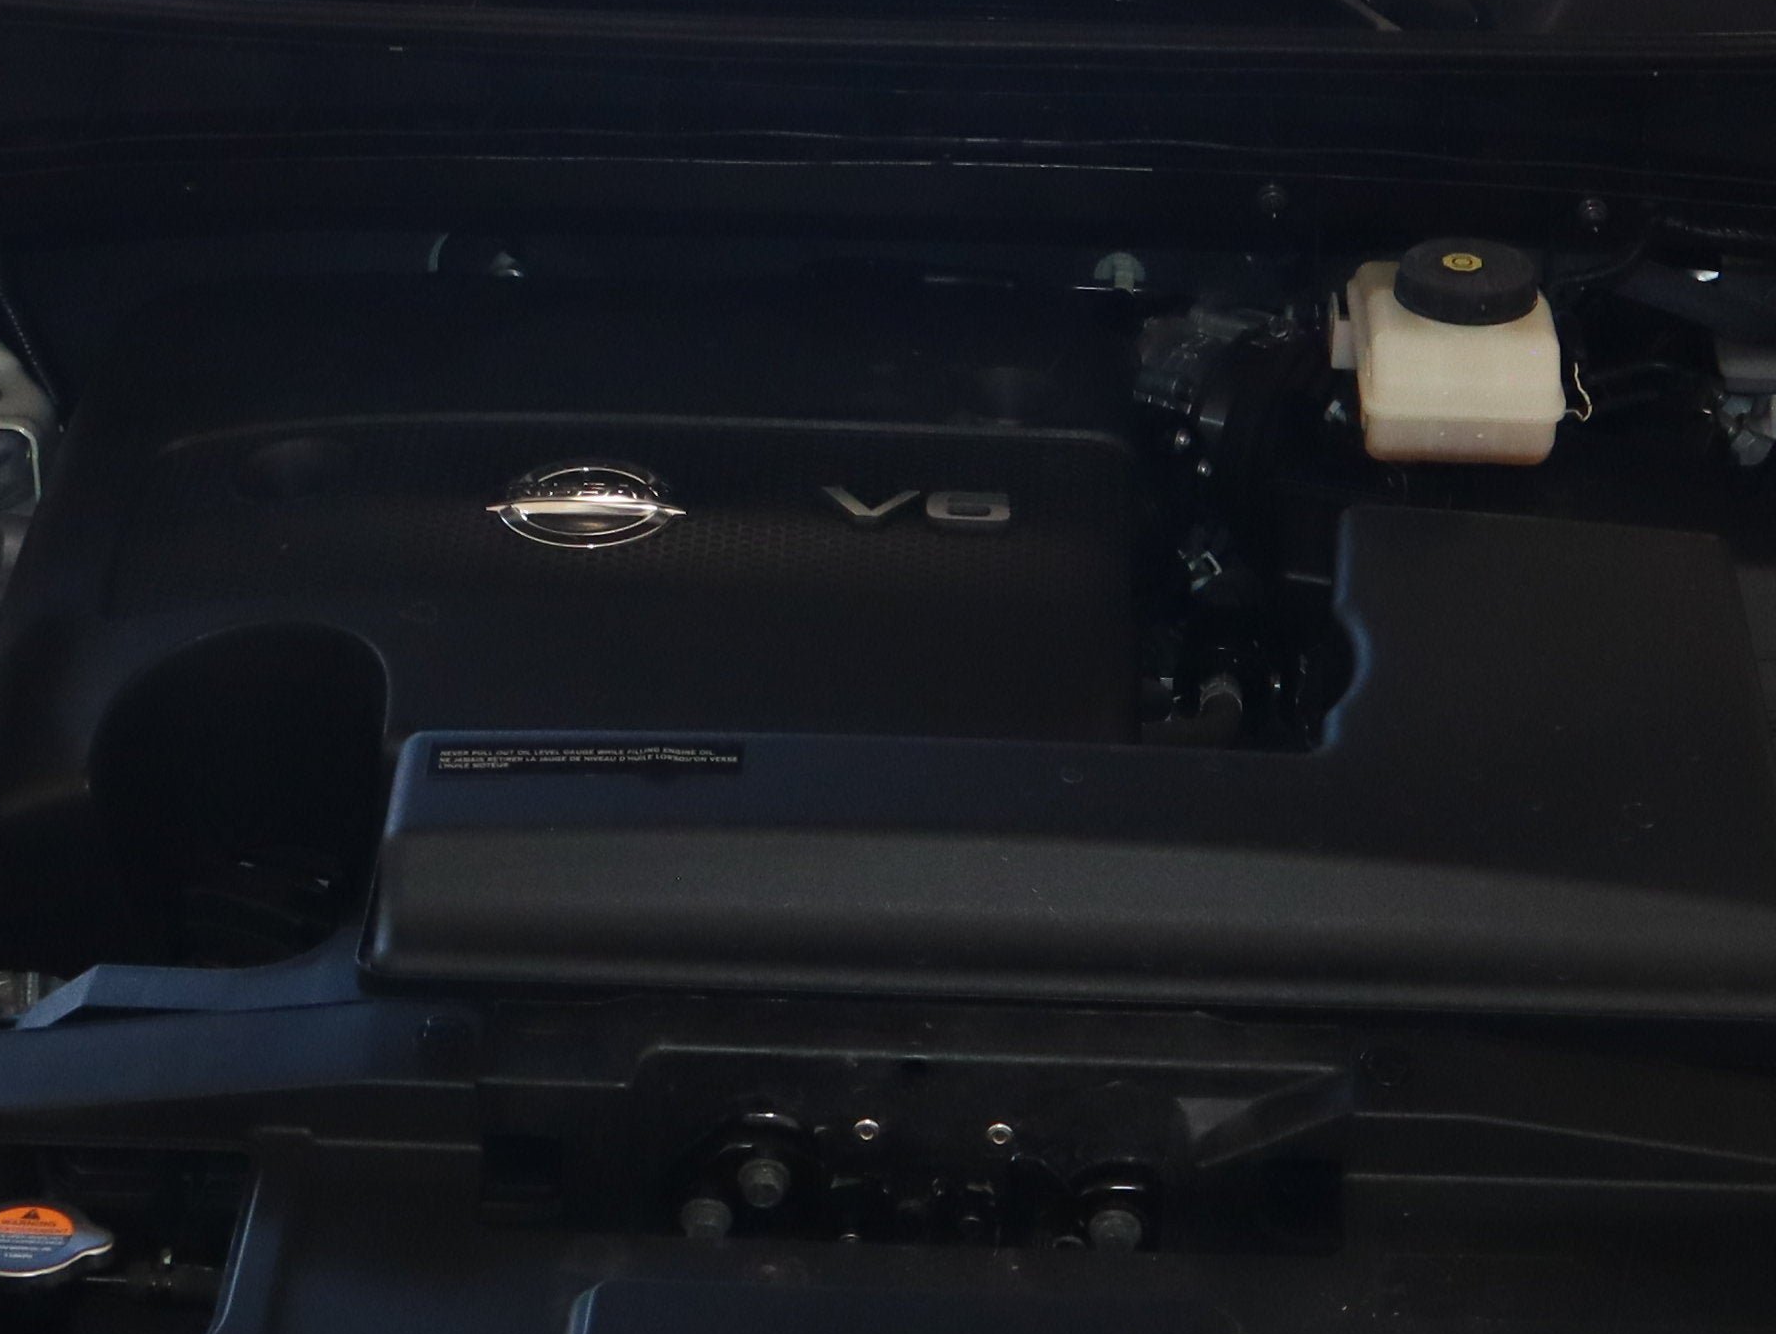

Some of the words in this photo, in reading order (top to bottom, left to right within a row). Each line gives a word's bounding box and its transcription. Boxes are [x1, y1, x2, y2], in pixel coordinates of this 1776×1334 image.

[821, 485, 1011, 521] V6
[626, 747, 660, 756] FILLING
[662, 747, 697, 755] ENGINE
